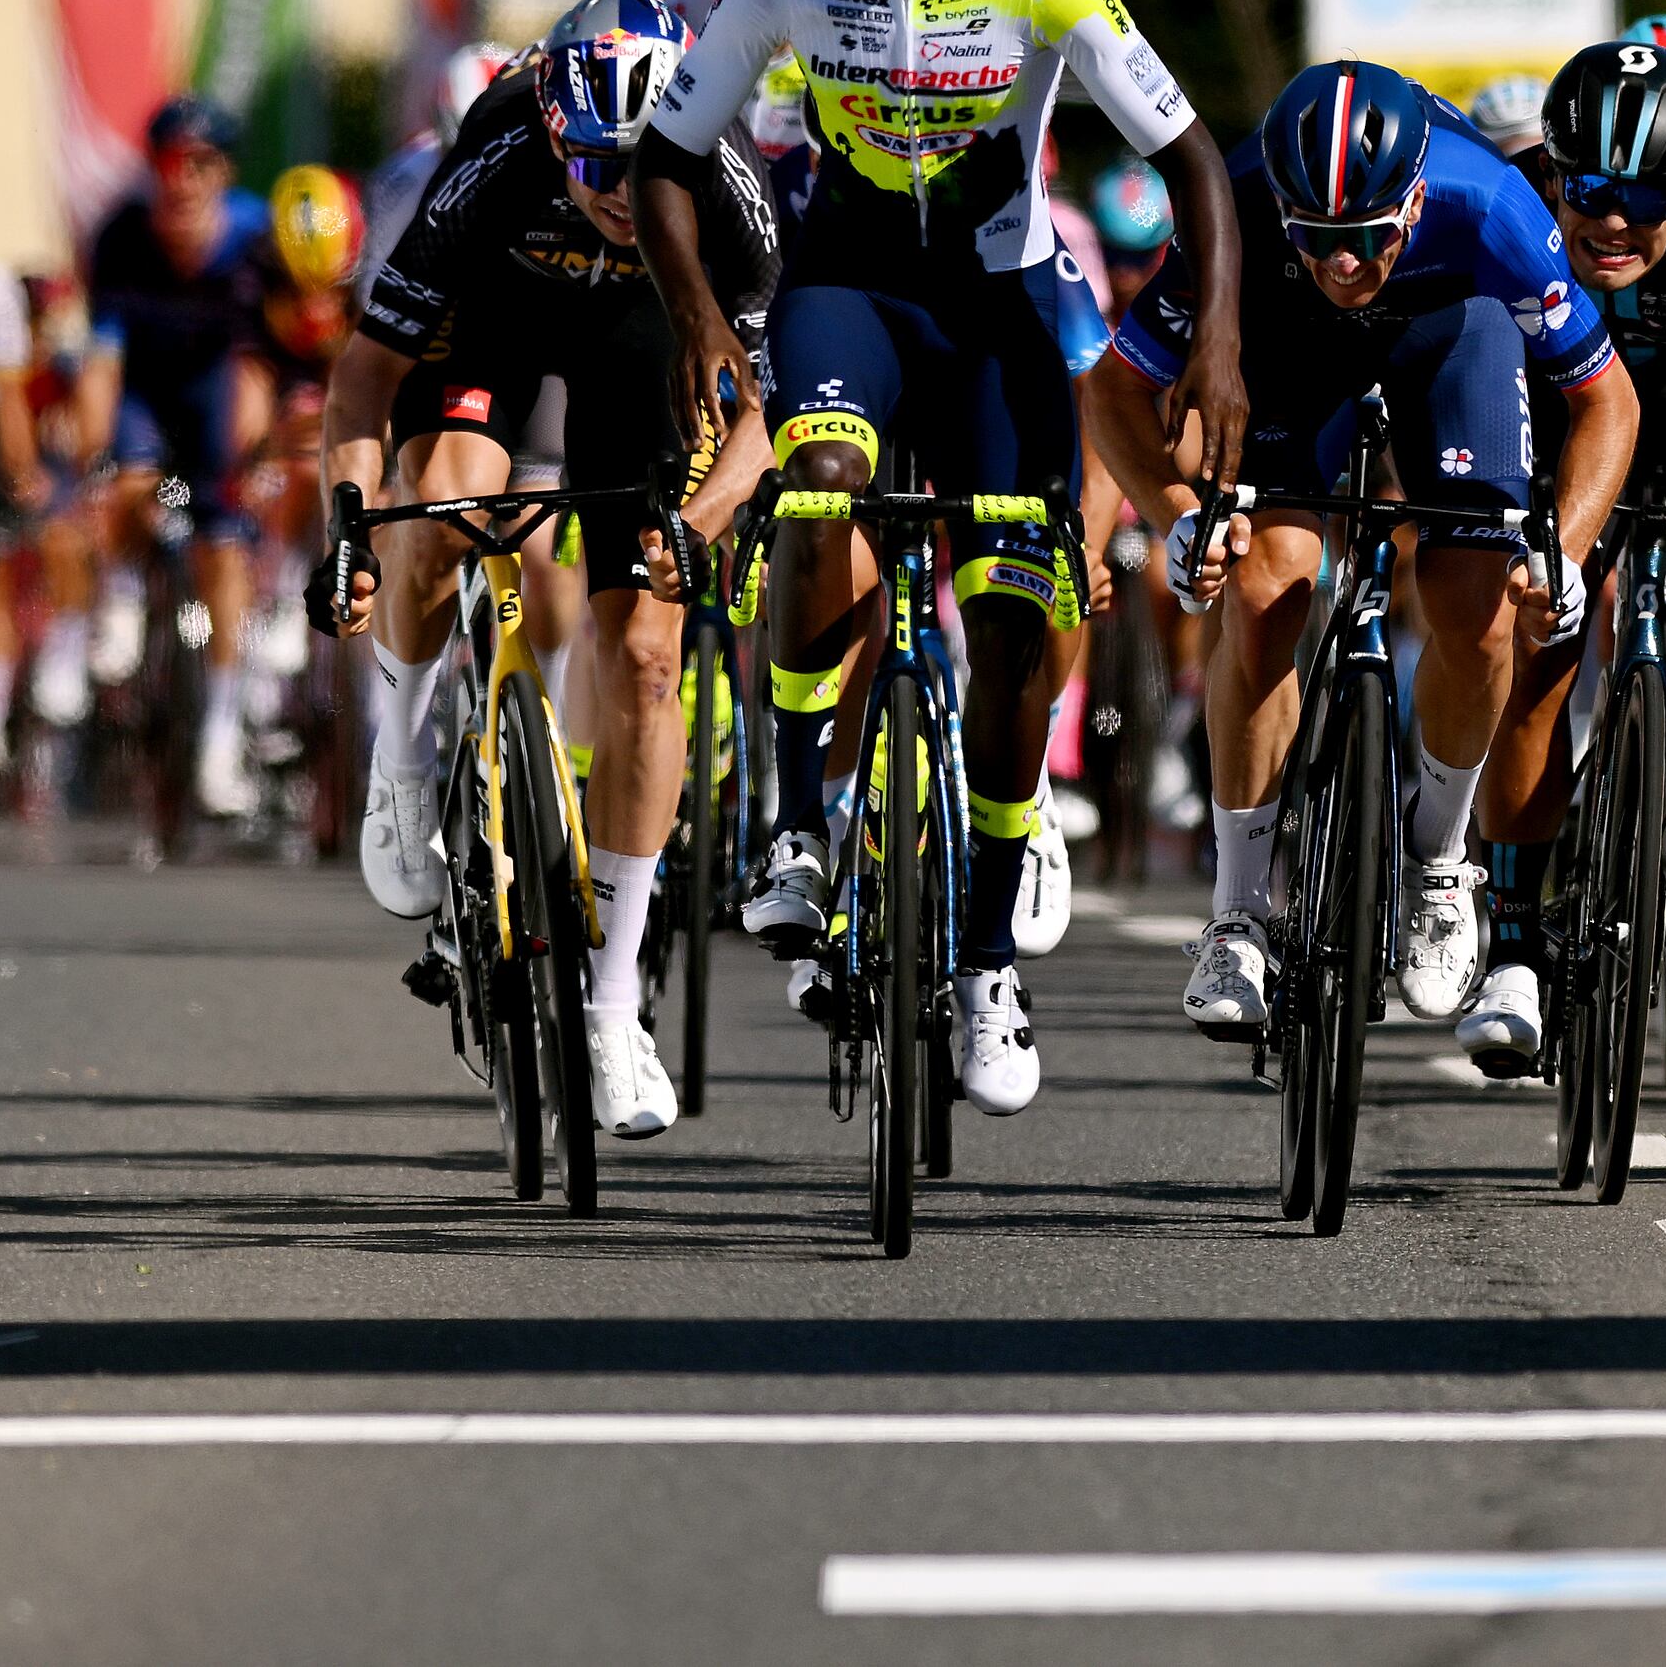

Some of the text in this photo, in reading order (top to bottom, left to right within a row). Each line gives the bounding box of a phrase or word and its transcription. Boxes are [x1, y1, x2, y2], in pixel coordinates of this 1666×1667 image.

[945, 7, 988, 20] bryton
[944, 45, 992, 57] Nalini
[568, 48, 588, 111] LAZER
[650, 47, 668, 109] LAZER
[840, 95, 975, 124] Circus
[1567, 98, 1577, 134] youfone
[446, 397, 485, 411] HEMA
[799, 400, 865, 415] CUBE
[787, 419, 868, 442] Circus
[669, 509, 692, 577] SRAM
[337, 539, 352, 606] SRAM
[897, 564, 912, 652] CUBE
[1504, 902, 1532, 913] DSM
